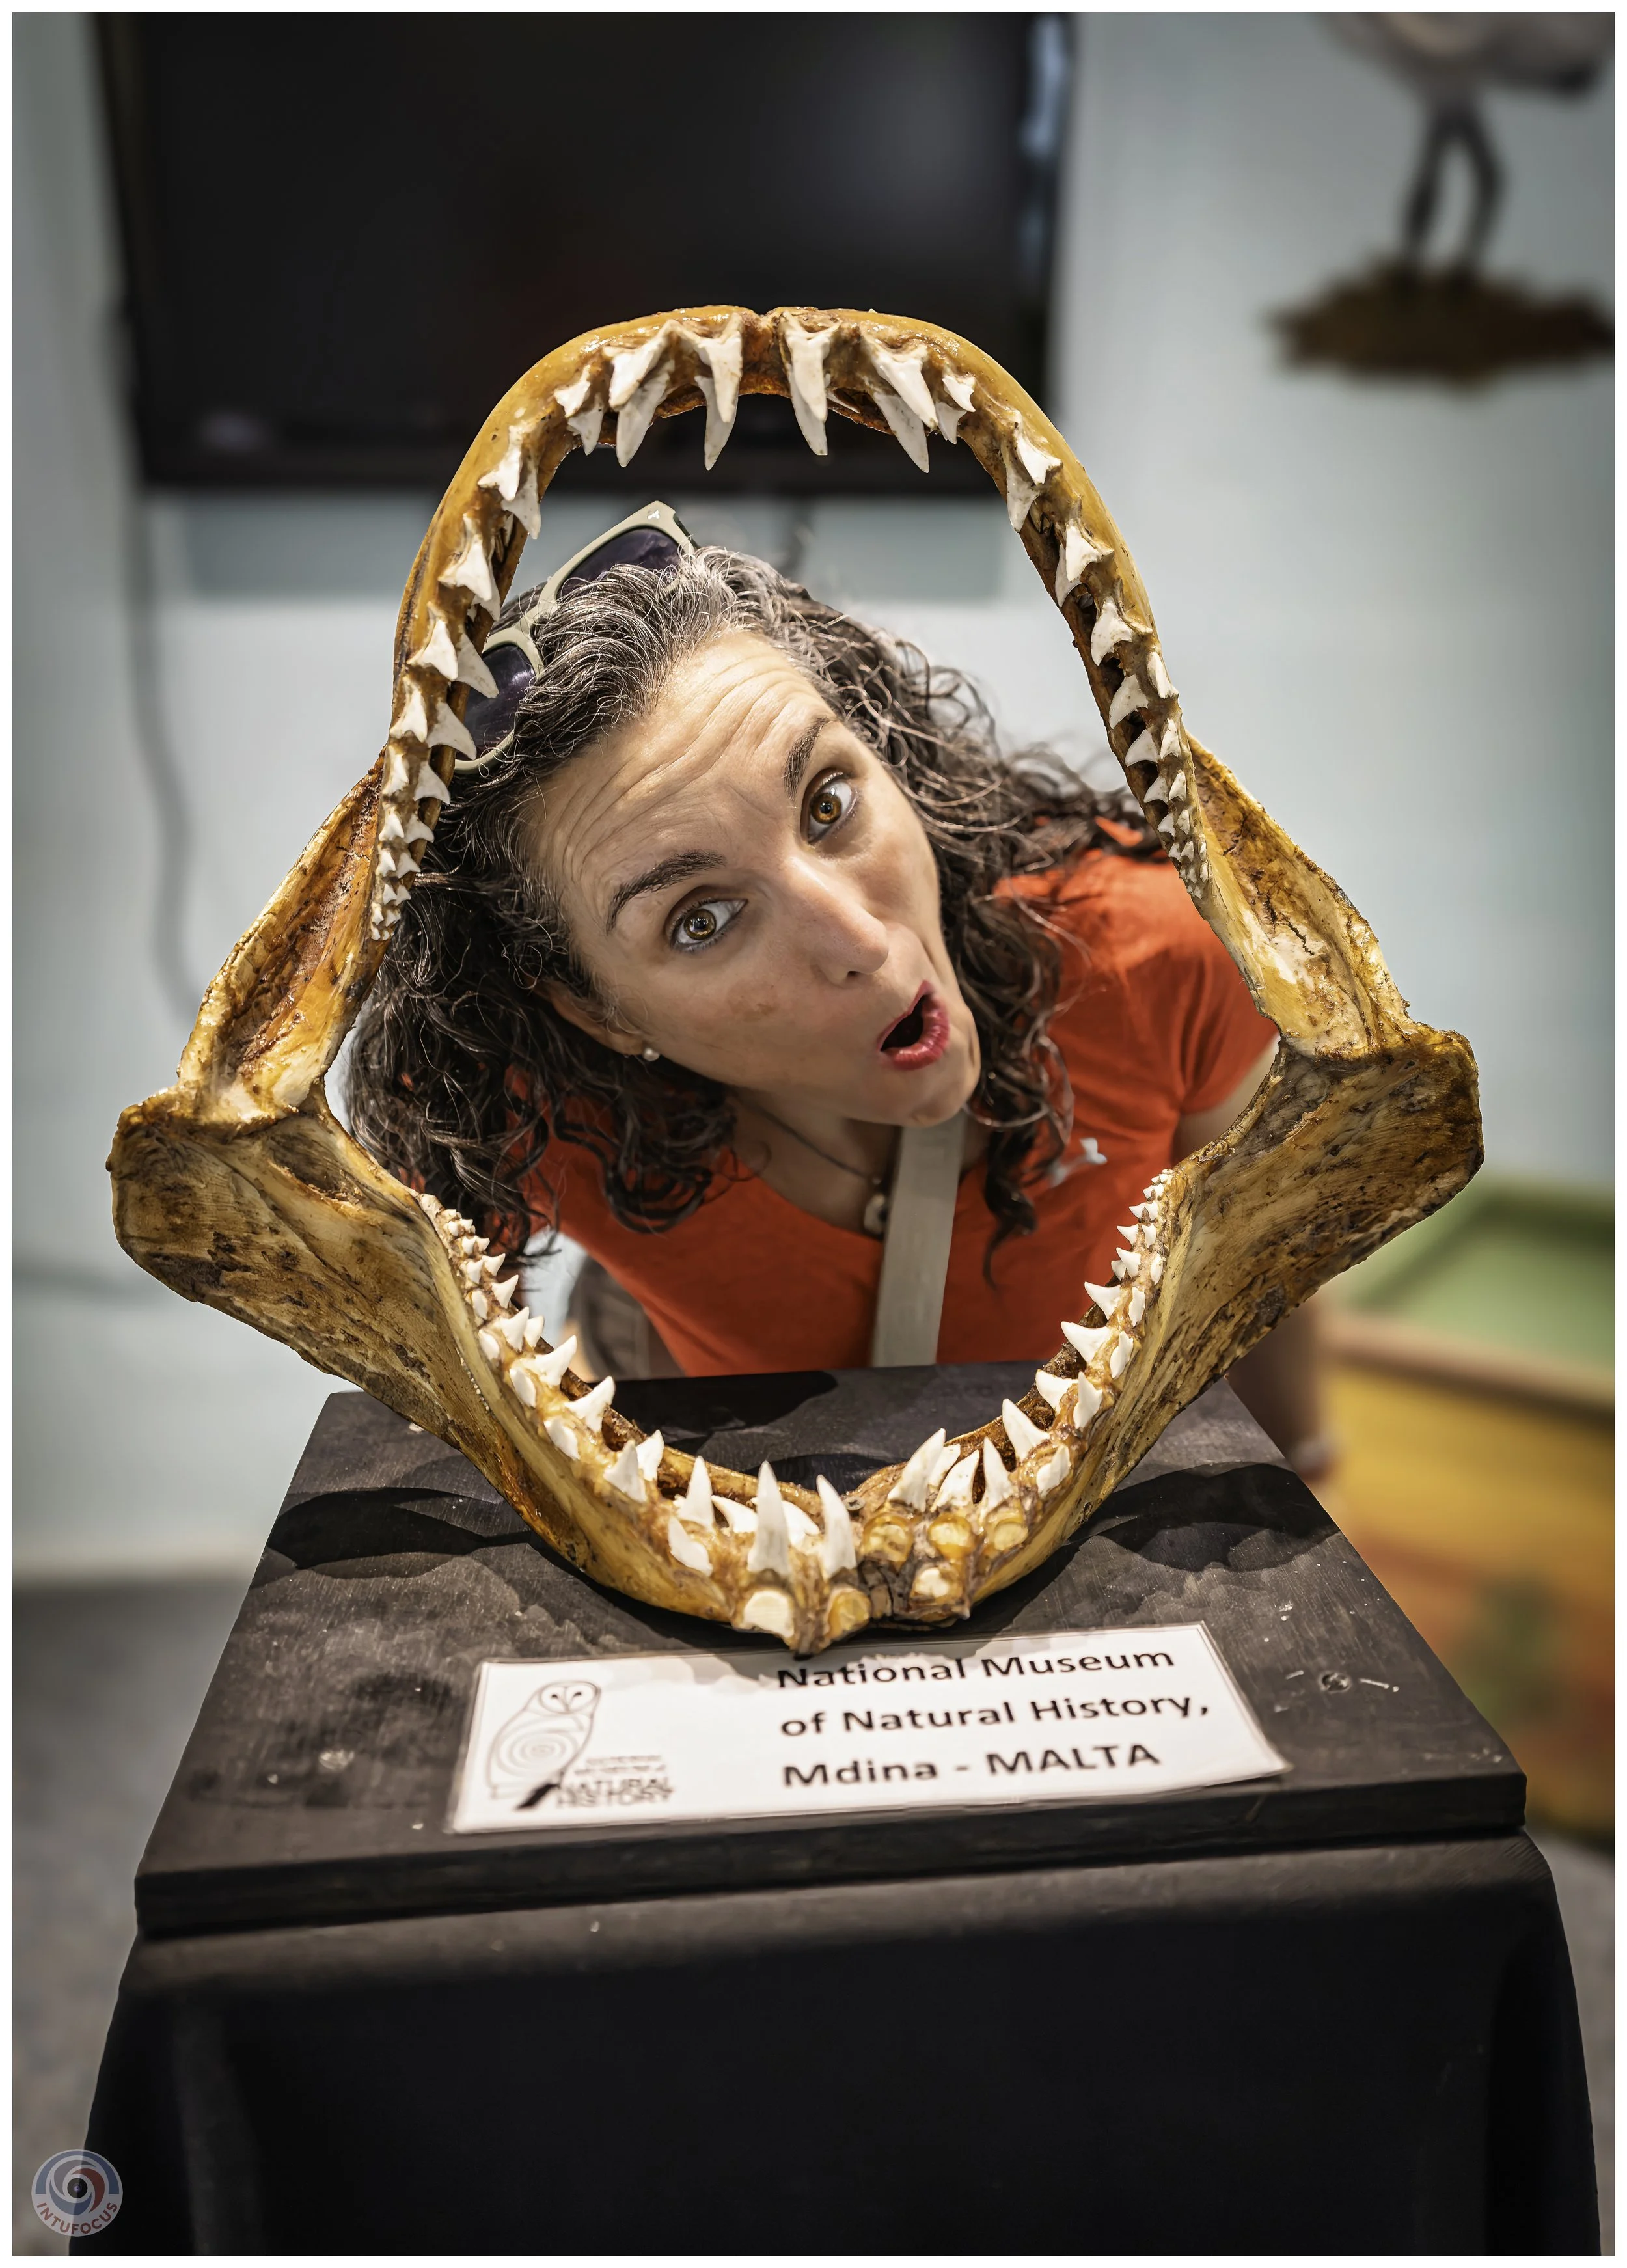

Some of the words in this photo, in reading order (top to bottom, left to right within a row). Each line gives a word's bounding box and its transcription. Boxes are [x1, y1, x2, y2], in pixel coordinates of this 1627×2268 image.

[778, 1657, 965, 1688] National
[982, 1651, 1175, 1677] Museum
[781, 1712, 826, 1737] of
[843, 1702, 1014, 1732] Natural
[1030, 1695, 1210, 1721] History,
[784, 1760, 938, 1788] Mdina
[986, 1743, 1161, 1776] MALTA
